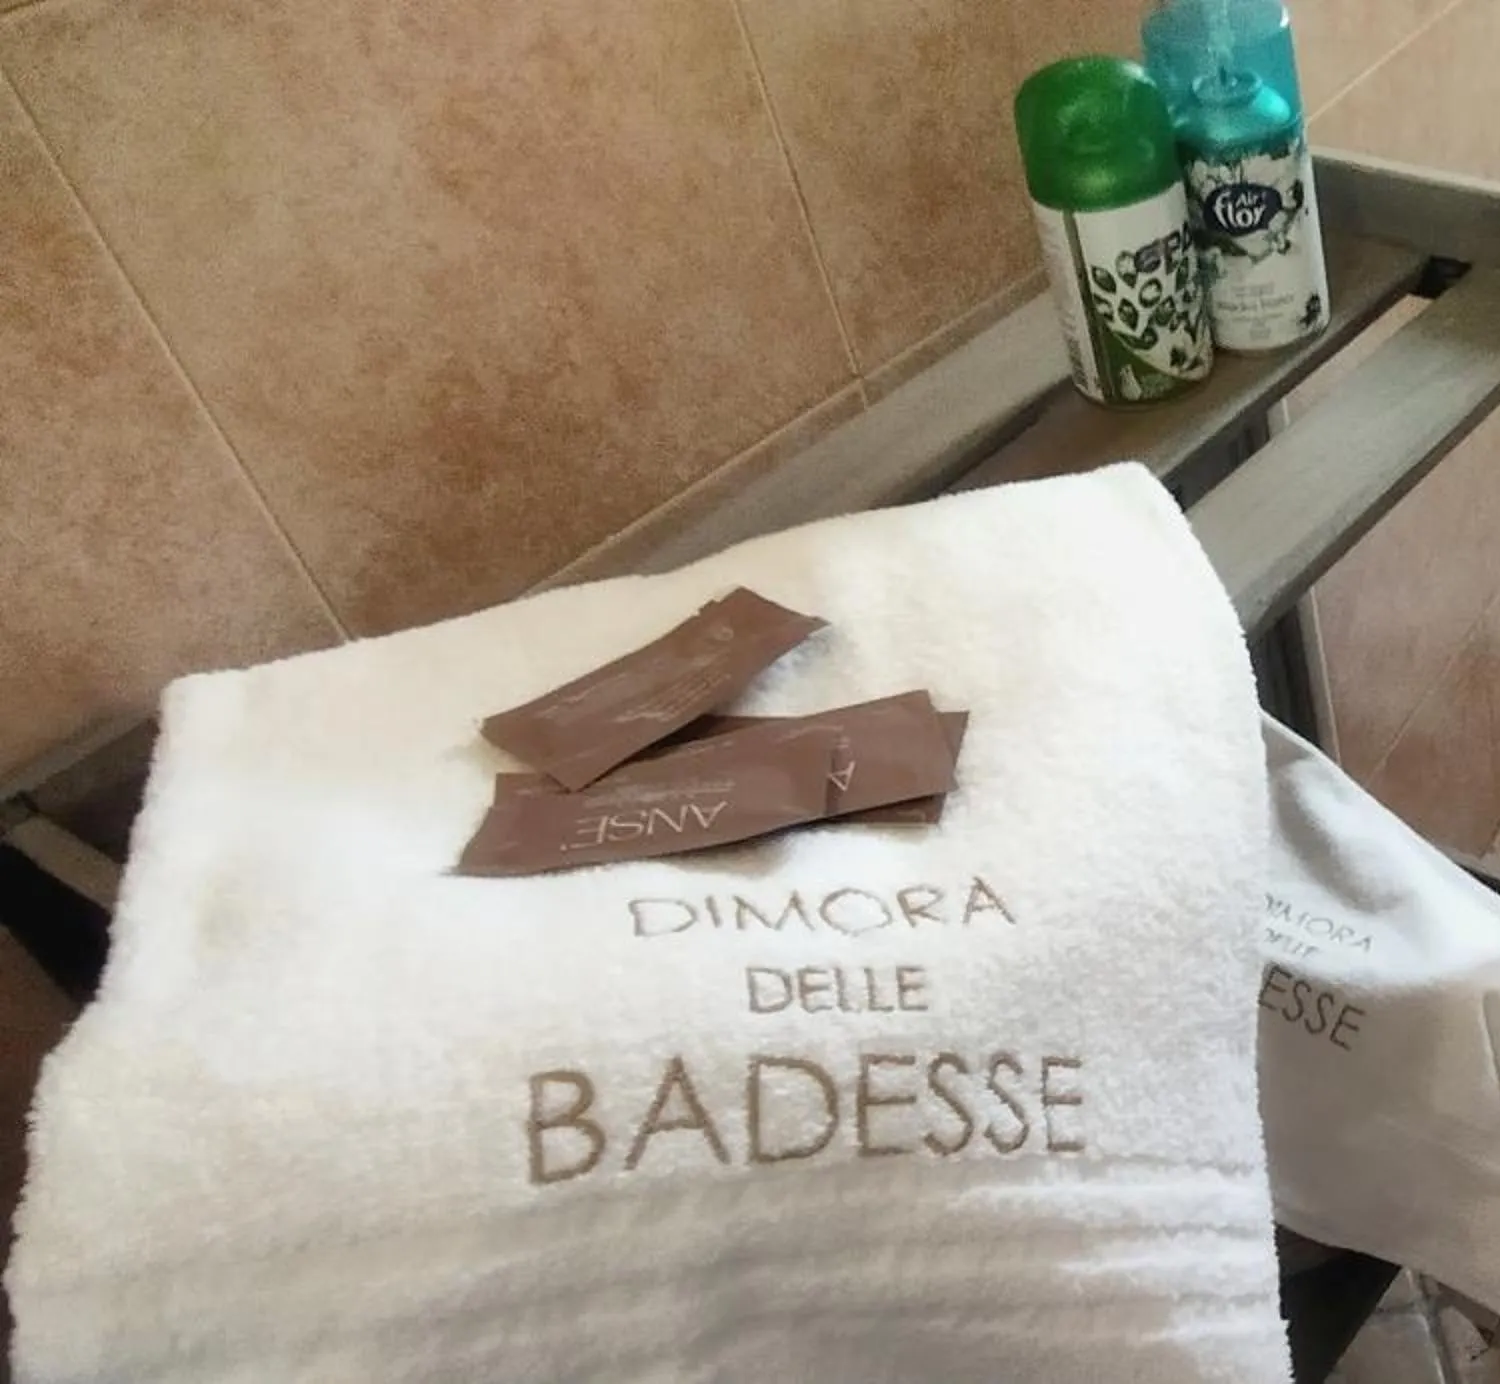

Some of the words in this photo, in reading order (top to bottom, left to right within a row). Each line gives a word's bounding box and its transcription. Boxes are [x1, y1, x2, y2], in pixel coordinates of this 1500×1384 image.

[627, 876, 1018, 937] DIMORA
[745, 964, 930, 1014] DELLE
[1257, 964, 1367, 1052] ESSE
[527, 1049, 1086, 1186] BADESSE
